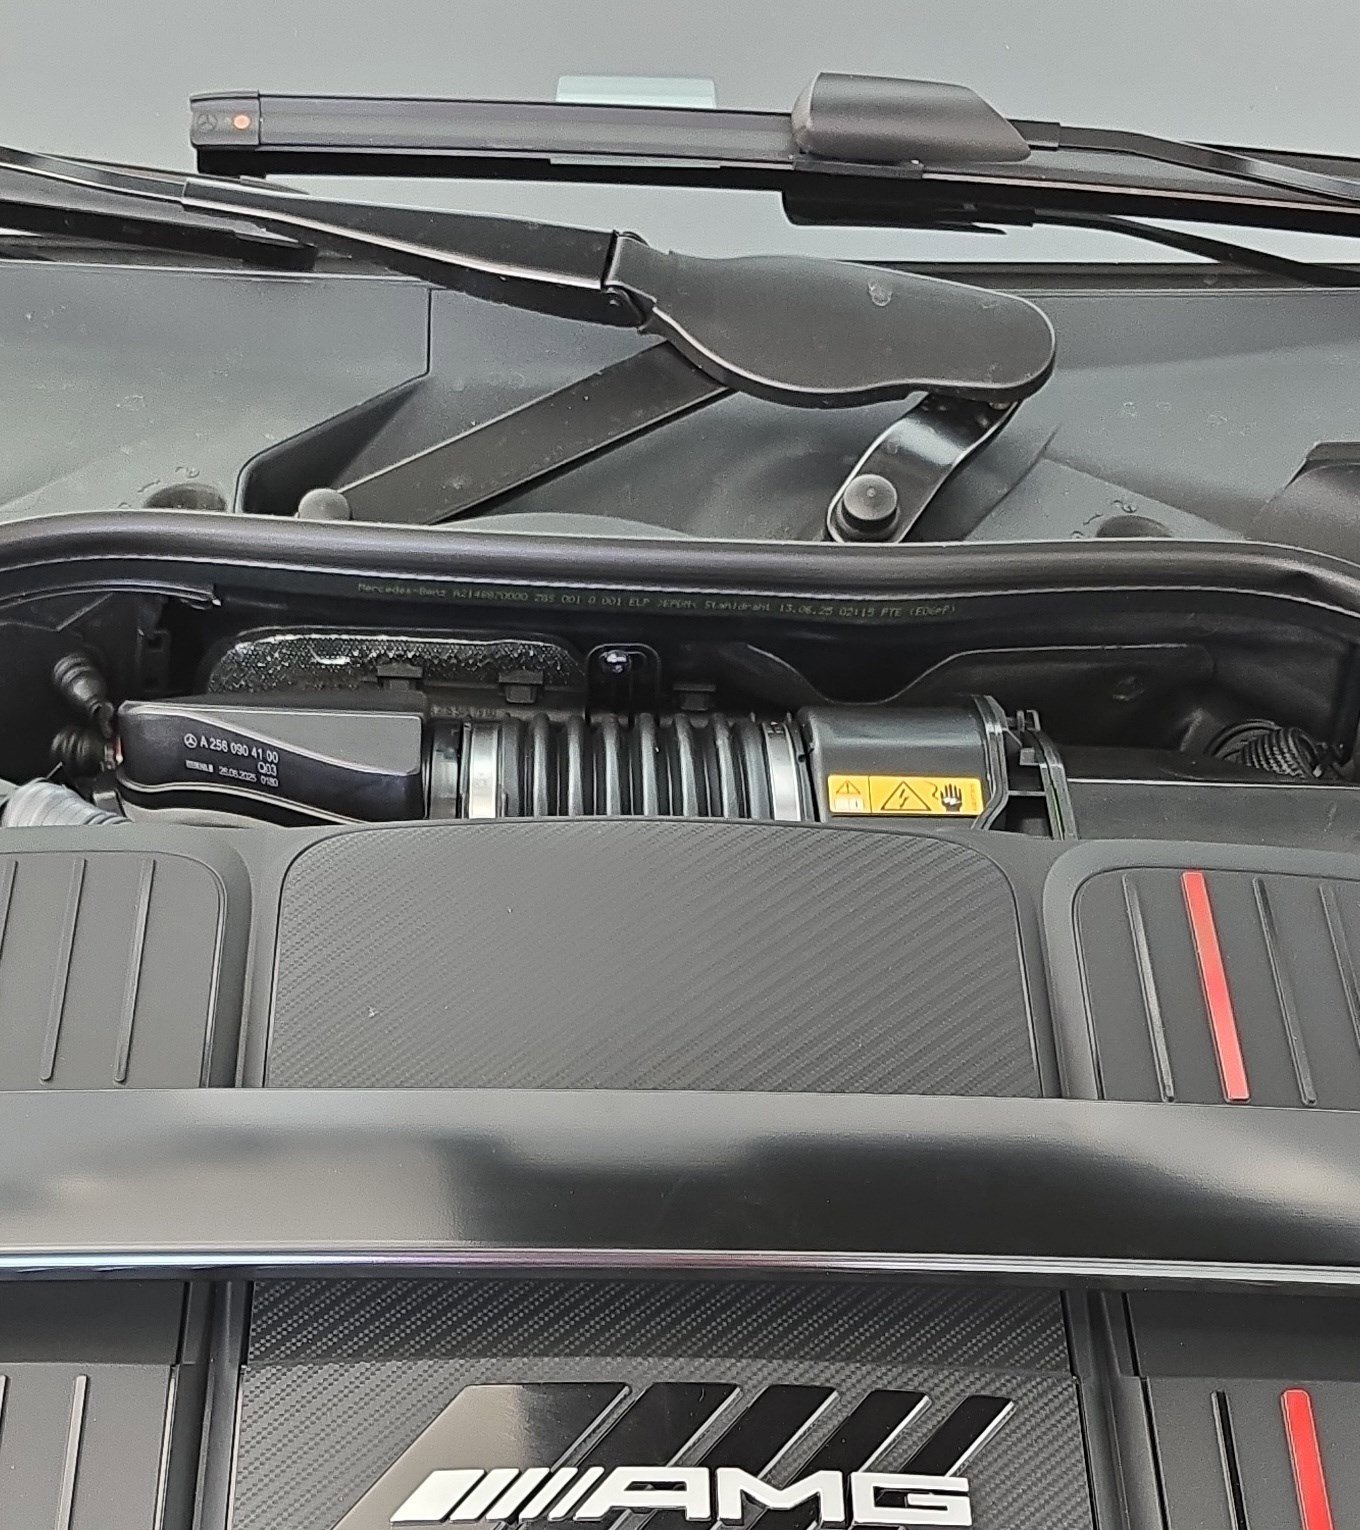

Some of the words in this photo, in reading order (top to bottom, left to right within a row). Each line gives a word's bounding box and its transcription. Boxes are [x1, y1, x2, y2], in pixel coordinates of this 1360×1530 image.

[200, 735, 209, 749] A
[251, 747, 263, 760] 41
[266, 751, 279, 763] 00
[572, 1466, 975, 1530] AMG
